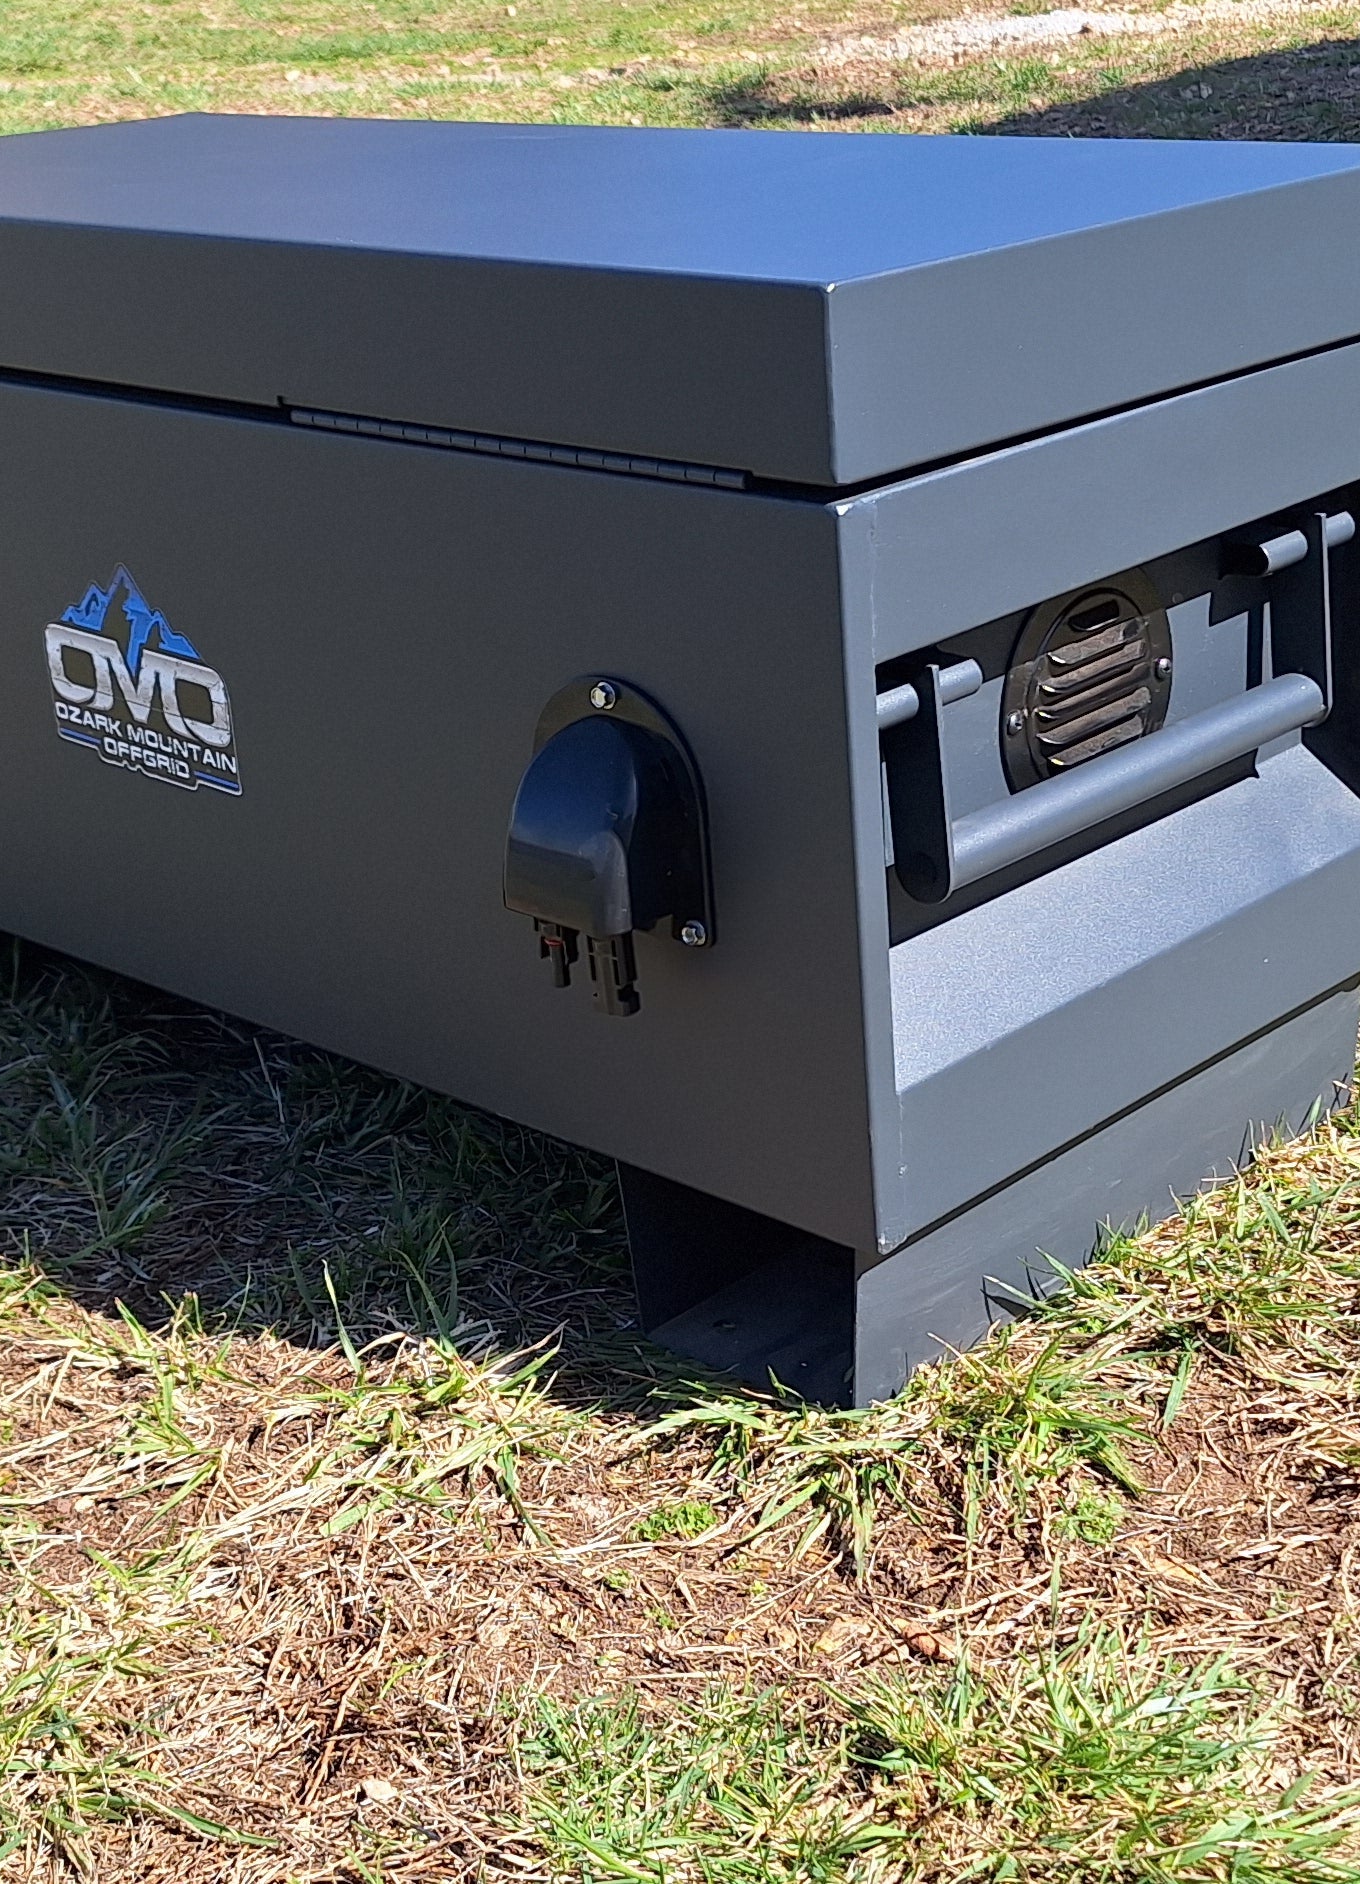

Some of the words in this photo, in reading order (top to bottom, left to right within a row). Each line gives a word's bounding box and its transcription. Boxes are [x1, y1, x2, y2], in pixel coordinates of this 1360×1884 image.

[55, 702, 122, 737] OZARK
[127, 724, 237, 773] MOUNTAIN
[103, 737, 190, 779] OFFGRID
